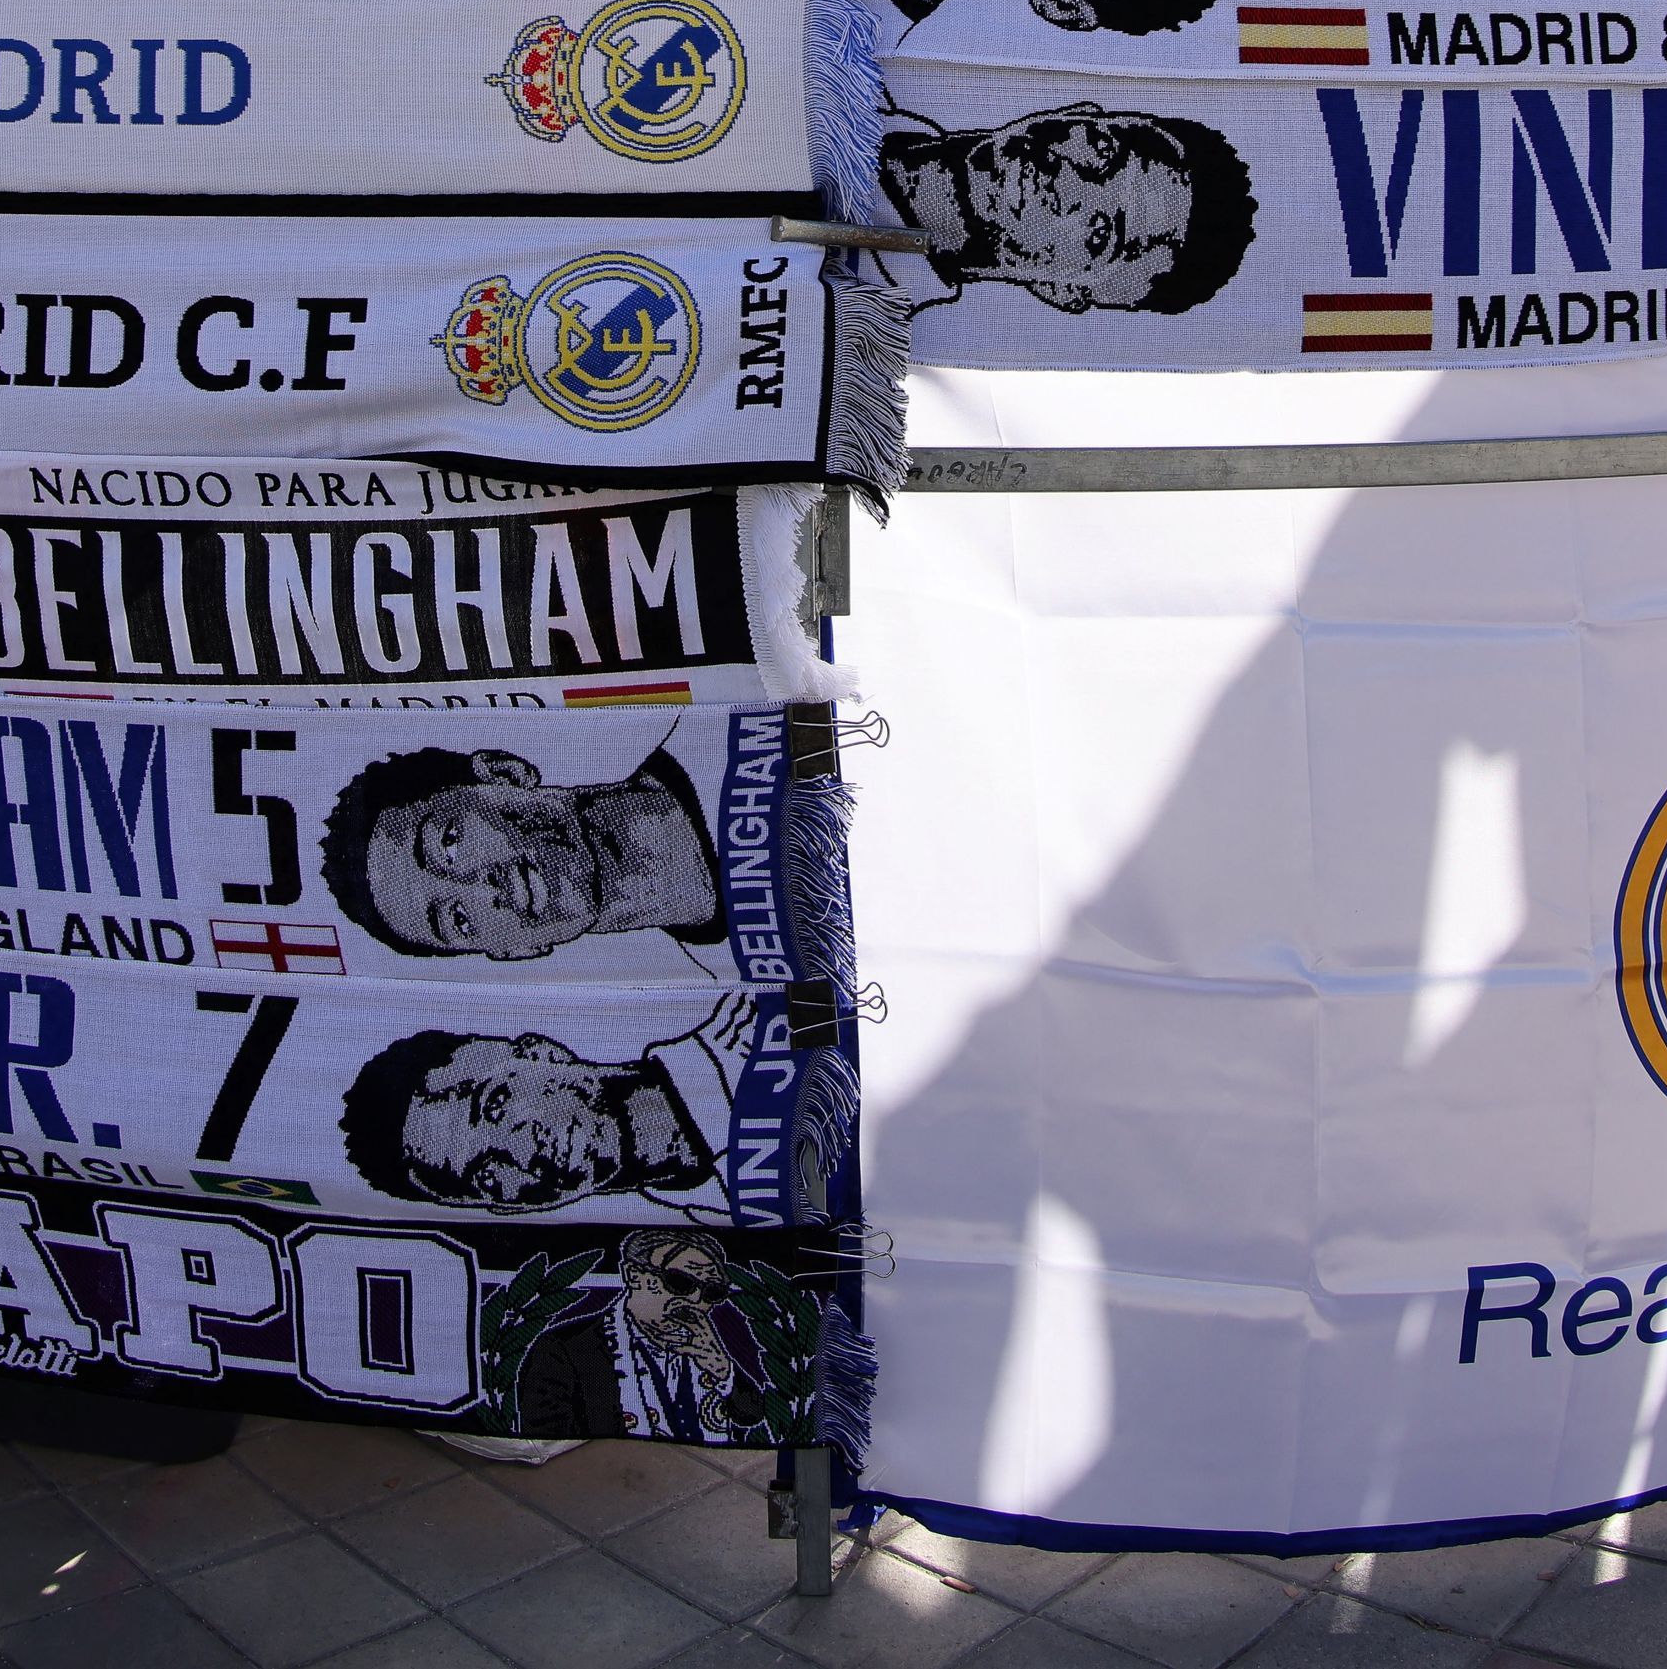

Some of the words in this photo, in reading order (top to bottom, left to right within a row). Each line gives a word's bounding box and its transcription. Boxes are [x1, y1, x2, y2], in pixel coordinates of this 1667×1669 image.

[1388, 11, 1638, 66] MADRID
[176, 294, 368, 393] C.F
[736, 254, 790, 411] RMFC
[29, 467, 232, 507] NACIDO
[254, 472, 396, 508] PARA
[210, 727, 303, 908] 5
[728, 713, 794, 983] BELLINGHAM
[194, 991, 300, 1162] 7
